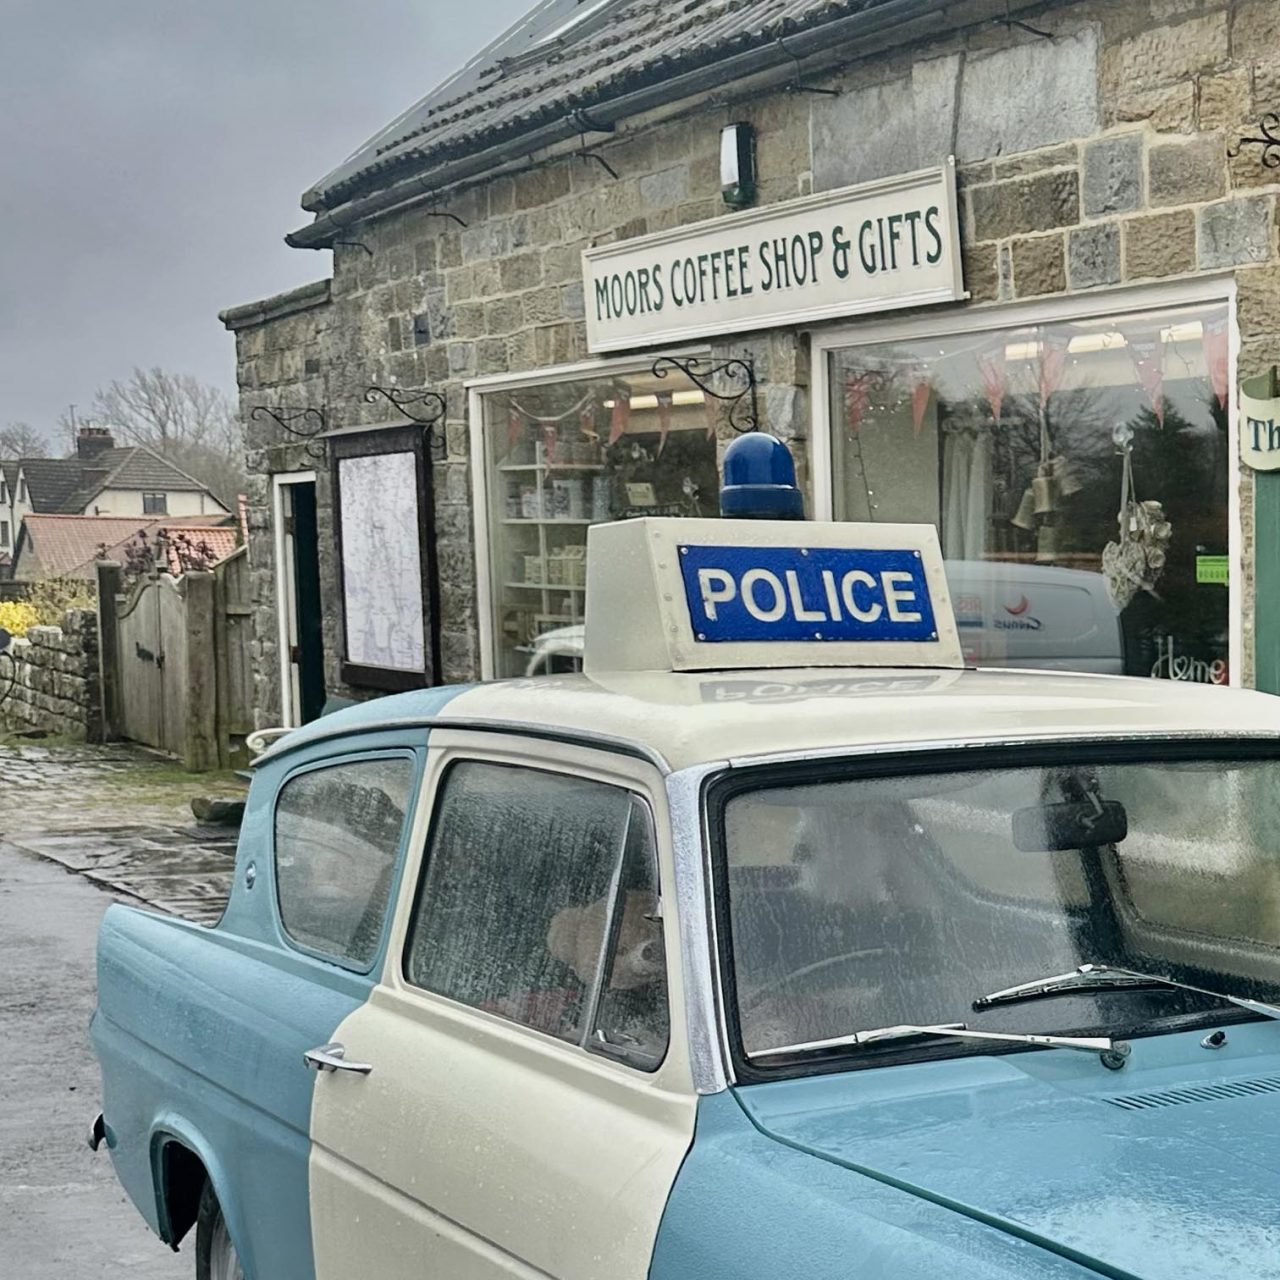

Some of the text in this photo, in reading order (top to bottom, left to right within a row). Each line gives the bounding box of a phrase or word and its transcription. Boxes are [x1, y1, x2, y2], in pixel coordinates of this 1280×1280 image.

[594, 206, 942, 321] MOORS COFFEE SHOP & GIFTS
[697, 567, 922, 623] POLICE
